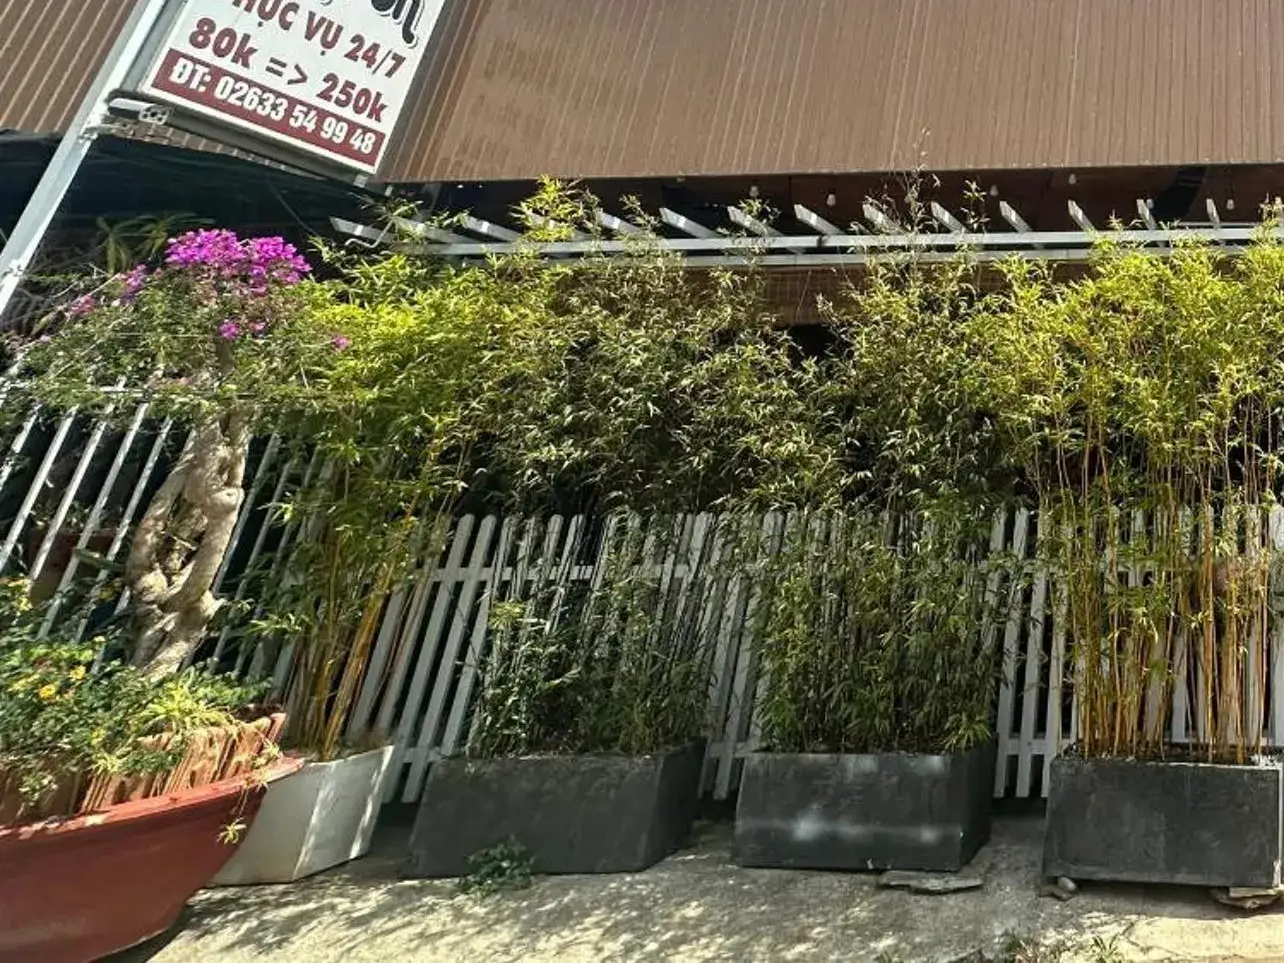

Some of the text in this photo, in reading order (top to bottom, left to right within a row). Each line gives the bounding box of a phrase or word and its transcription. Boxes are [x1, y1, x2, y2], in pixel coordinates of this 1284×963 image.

[189, 17, 258, 69] 80k
[316, 73, 388, 123] 250k
[304, 11, 344, 57] VỤ
[344, 34, 406, 78] 24/7
[168, 57, 376, 155] ĐT: 02633 54 99 48
